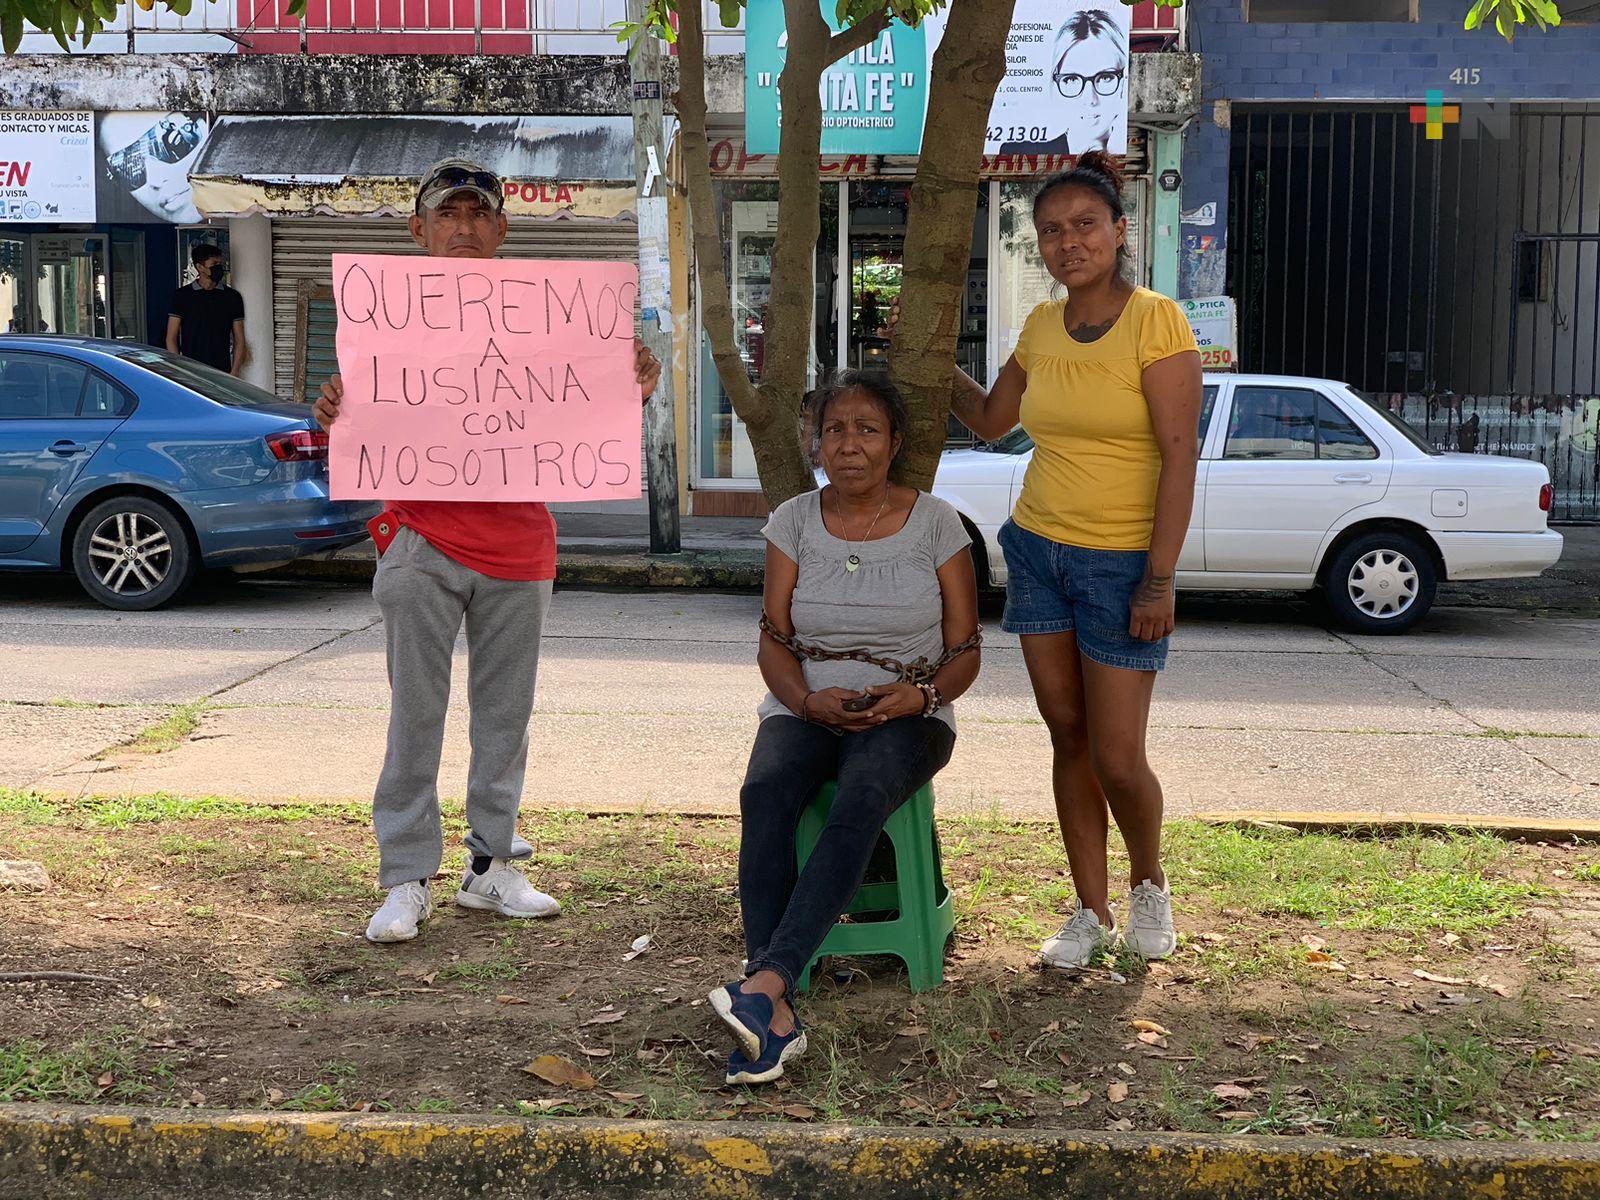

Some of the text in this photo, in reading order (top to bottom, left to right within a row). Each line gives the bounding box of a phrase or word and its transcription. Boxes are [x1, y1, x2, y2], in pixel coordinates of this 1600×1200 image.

[1009, 23, 1053, 31] ROFESIONAL
[1449, 67, 1480, 85] 415
[14, 112, 75, 122] GRADUADOS
[76, 112, 90, 121] DE
[836, 116, 894, 128] OPTOMETRICO
[0, 124, 90, 133] ONTACTO Y MICAS.
[1006, 126, 1026, 142] 13
[1029, 126, 1048, 142] 01
[60, 136, 88, 145] Crizal
[5, 190, 28, 198] VISTA
[341, 263, 637, 340] QUEREMOS
[480, 338, 509, 367] A
[373, 355, 590, 406] LUSIANA
[462, 409, 525, 436] CON
[357, 439, 631, 490] NOSOTROS
